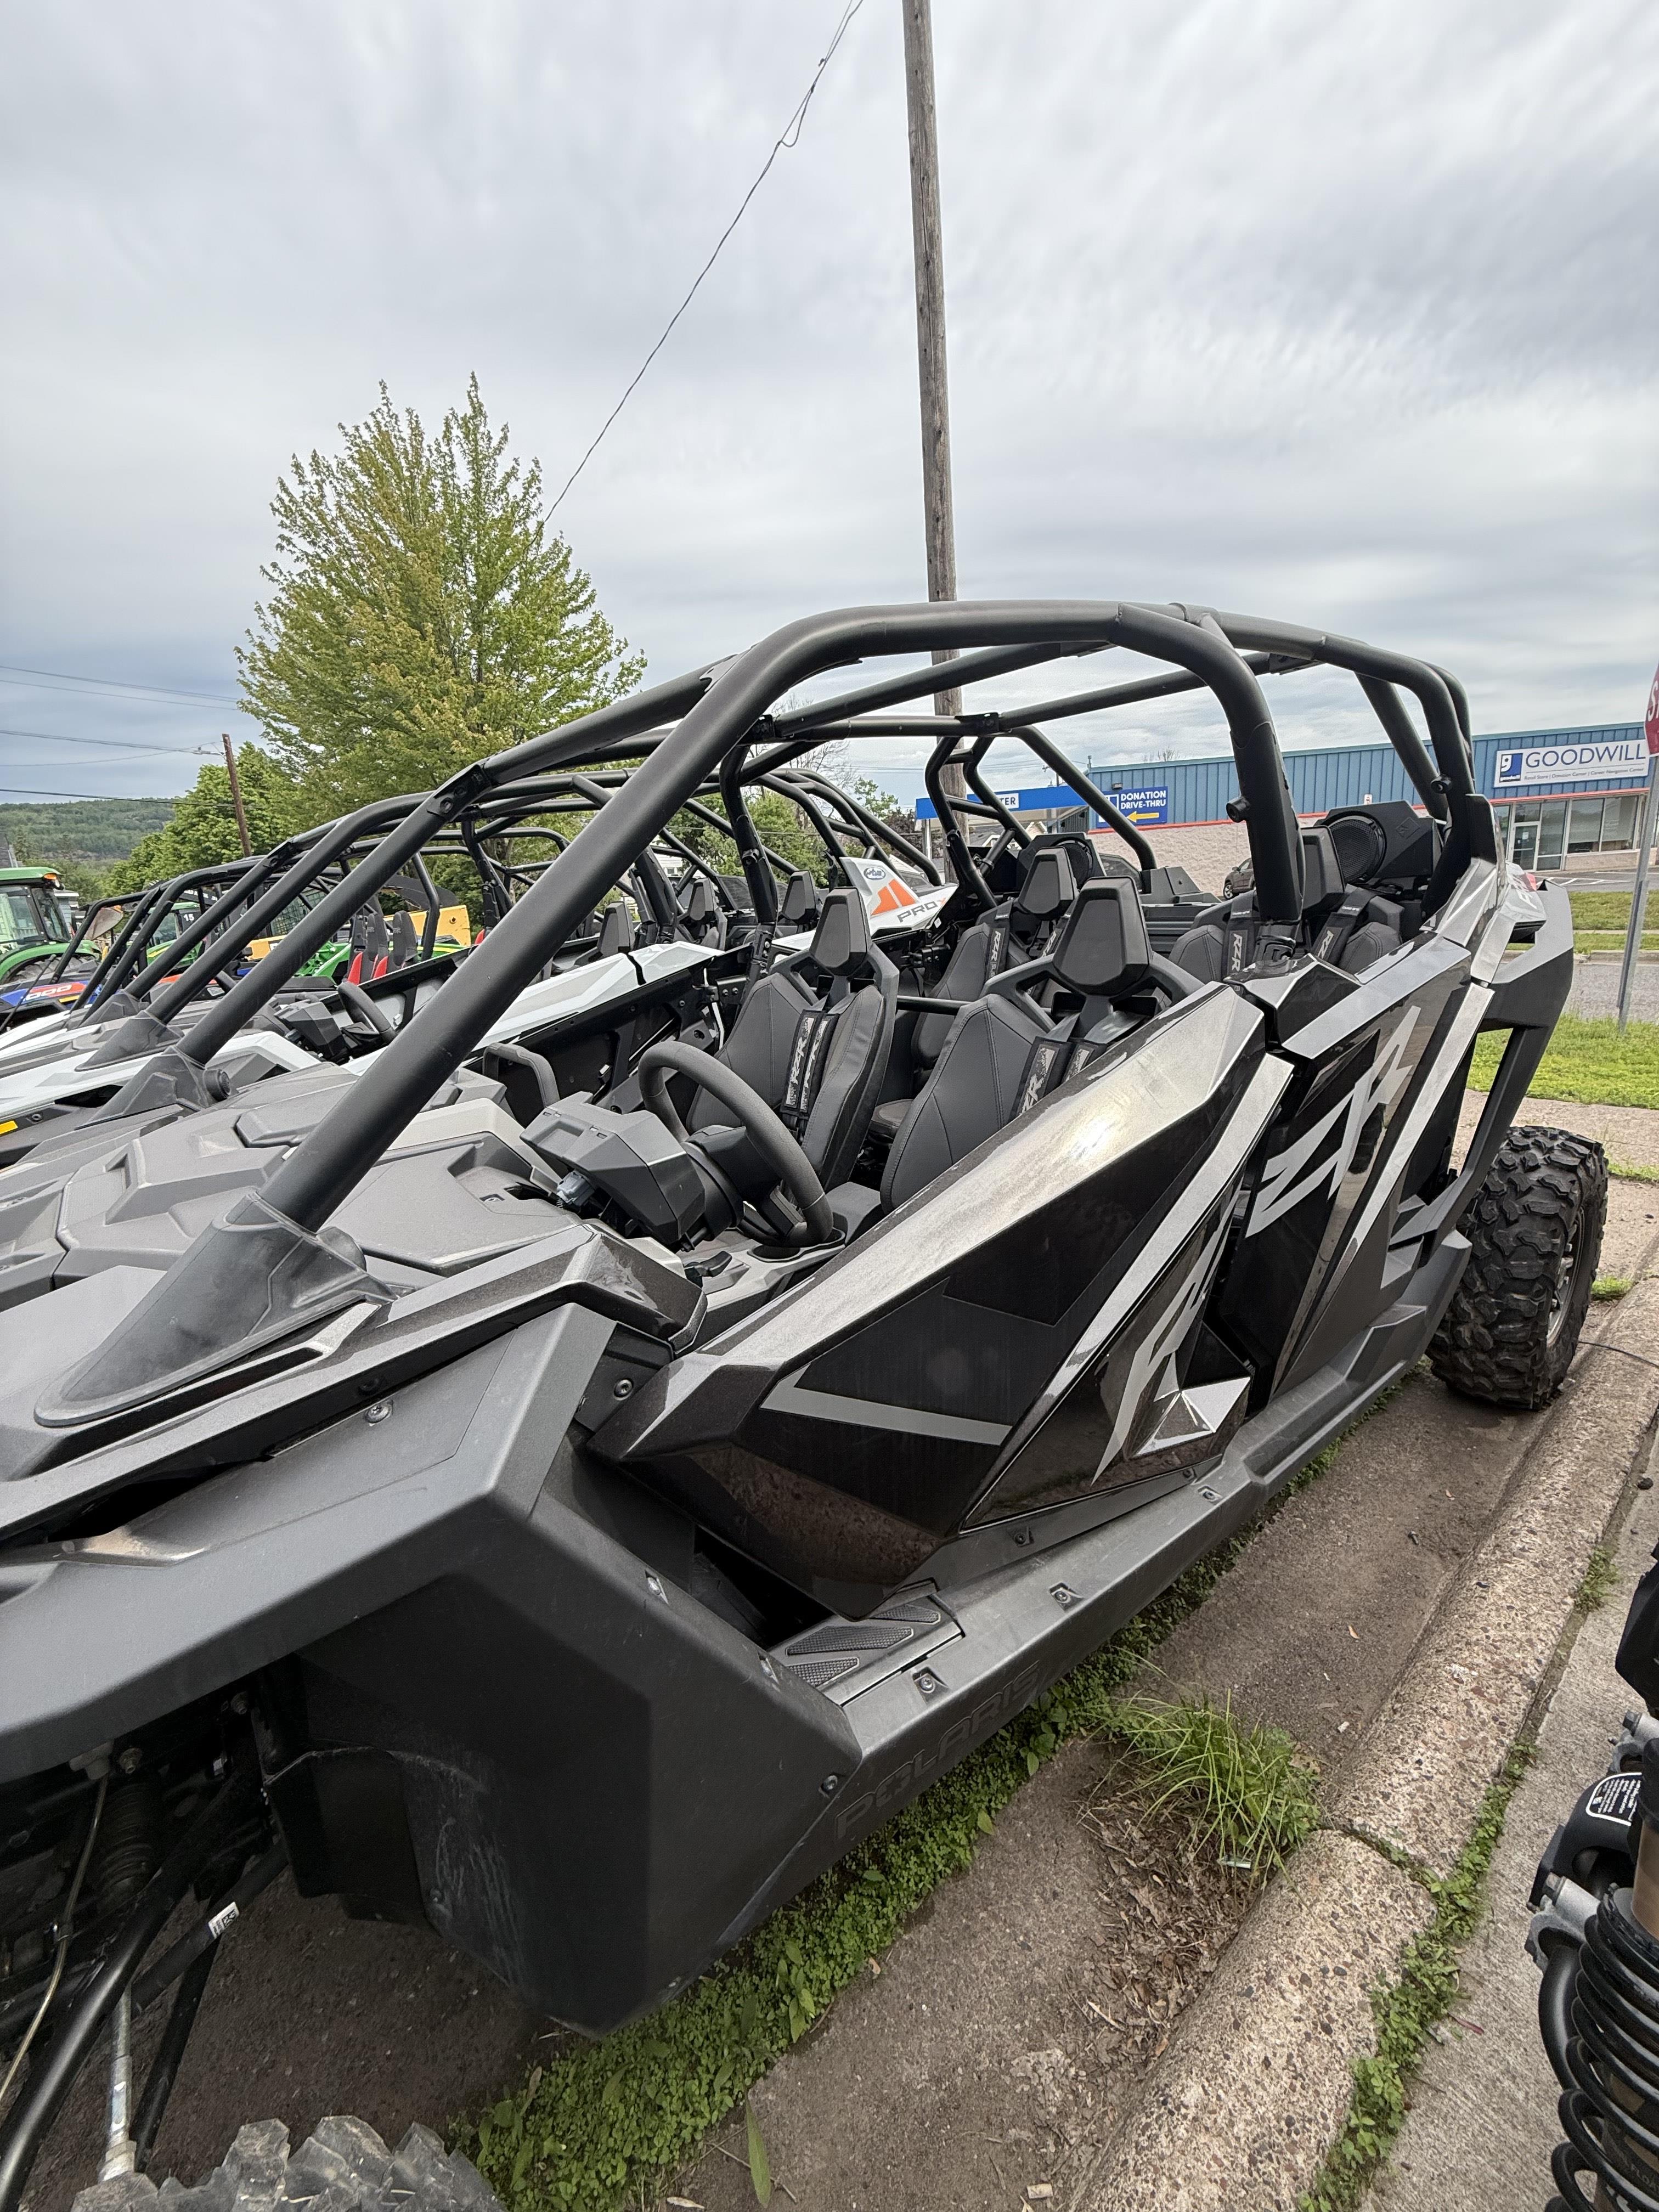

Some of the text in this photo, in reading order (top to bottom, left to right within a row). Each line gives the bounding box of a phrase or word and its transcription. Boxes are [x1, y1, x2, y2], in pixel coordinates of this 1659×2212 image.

[1525, 744, 1646, 768] GOODWILL
[999, 797, 1016, 806] TER
[1120, 790, 1166, 800] DONATION
[1120, 799, 1166, 809] DRIVE-THRU
[183, 913, 195, 922] 15
[897, 901, 938, 923] PRO
[991, 931, 1001, 961] RZR
[1231, 934, 1243, 972] RZR
[1317, 930, 1334, 960] RZ
[790, 1037, 807, 1085] RZR
[1019, 1073, 1045, 1115] ZR
[834, 1659, 1041, 1842] POLARIS
